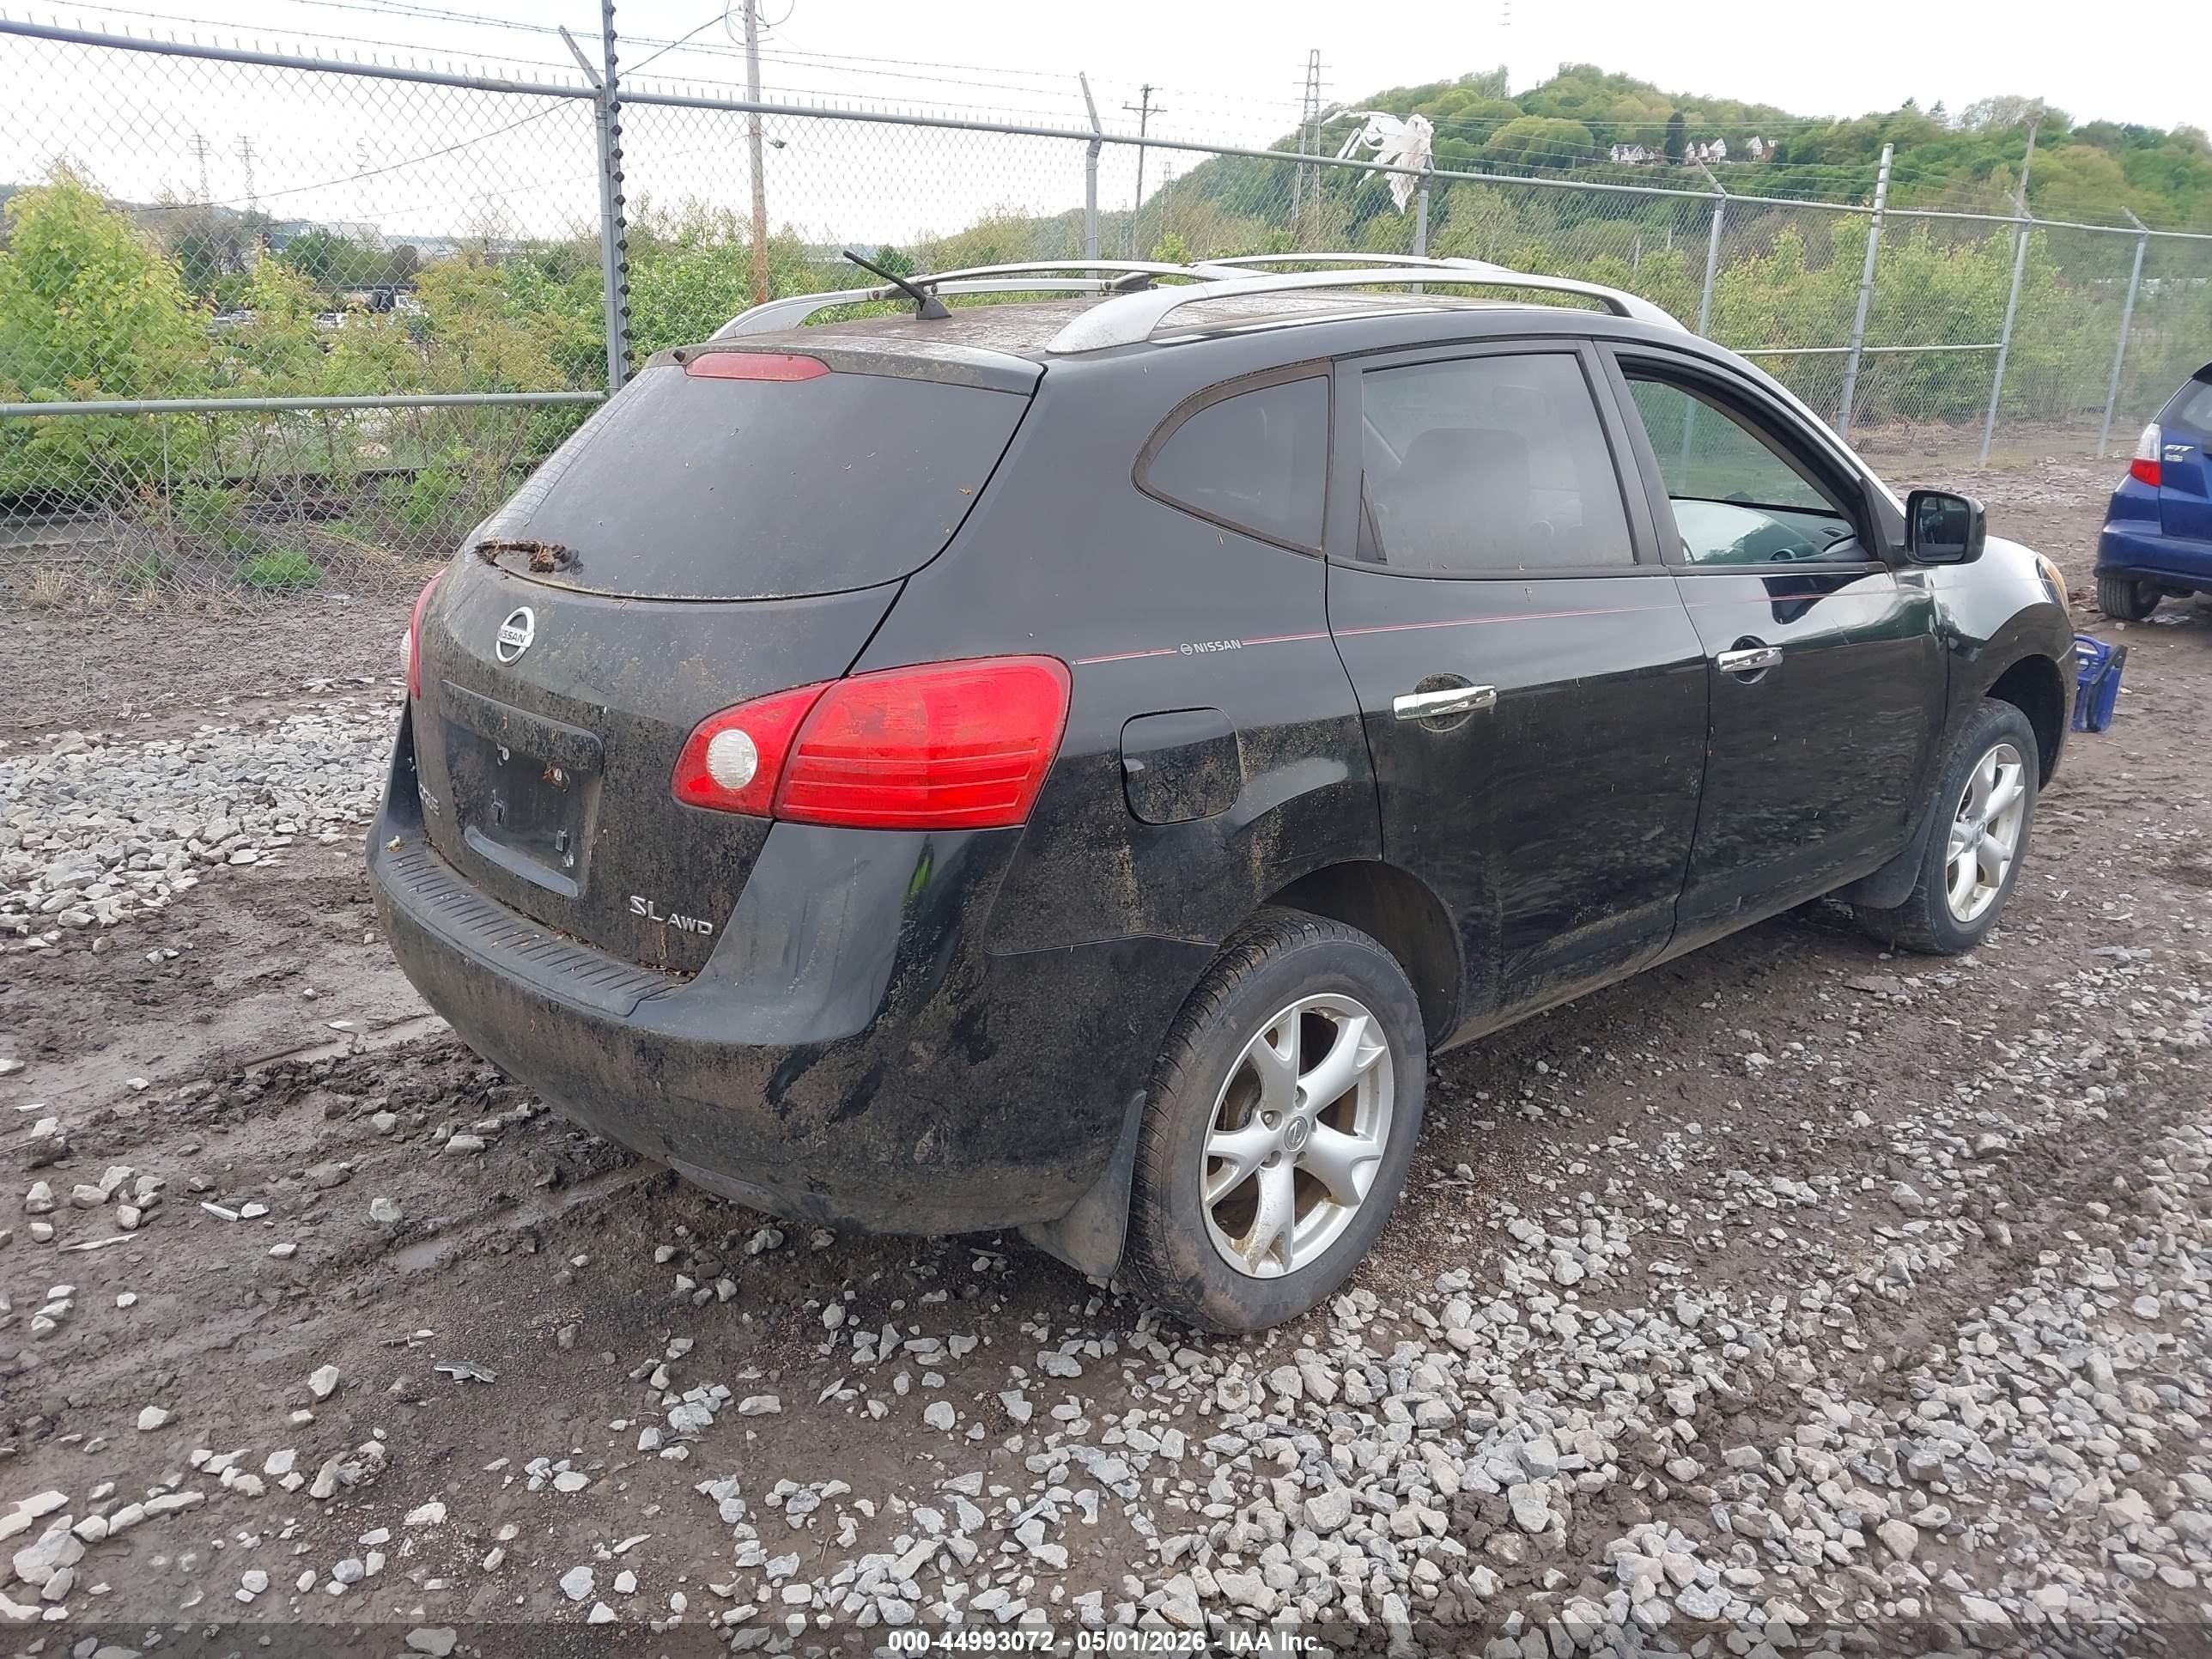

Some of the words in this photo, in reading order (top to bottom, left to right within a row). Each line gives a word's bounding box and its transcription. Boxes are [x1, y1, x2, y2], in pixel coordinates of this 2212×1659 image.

[498, 629, 526, 644] ISSAN
[1193, 639, 1243, 653] NISSAN
[629, 895, 665, 921] SL
[667, 913, 714, 936] AWD
